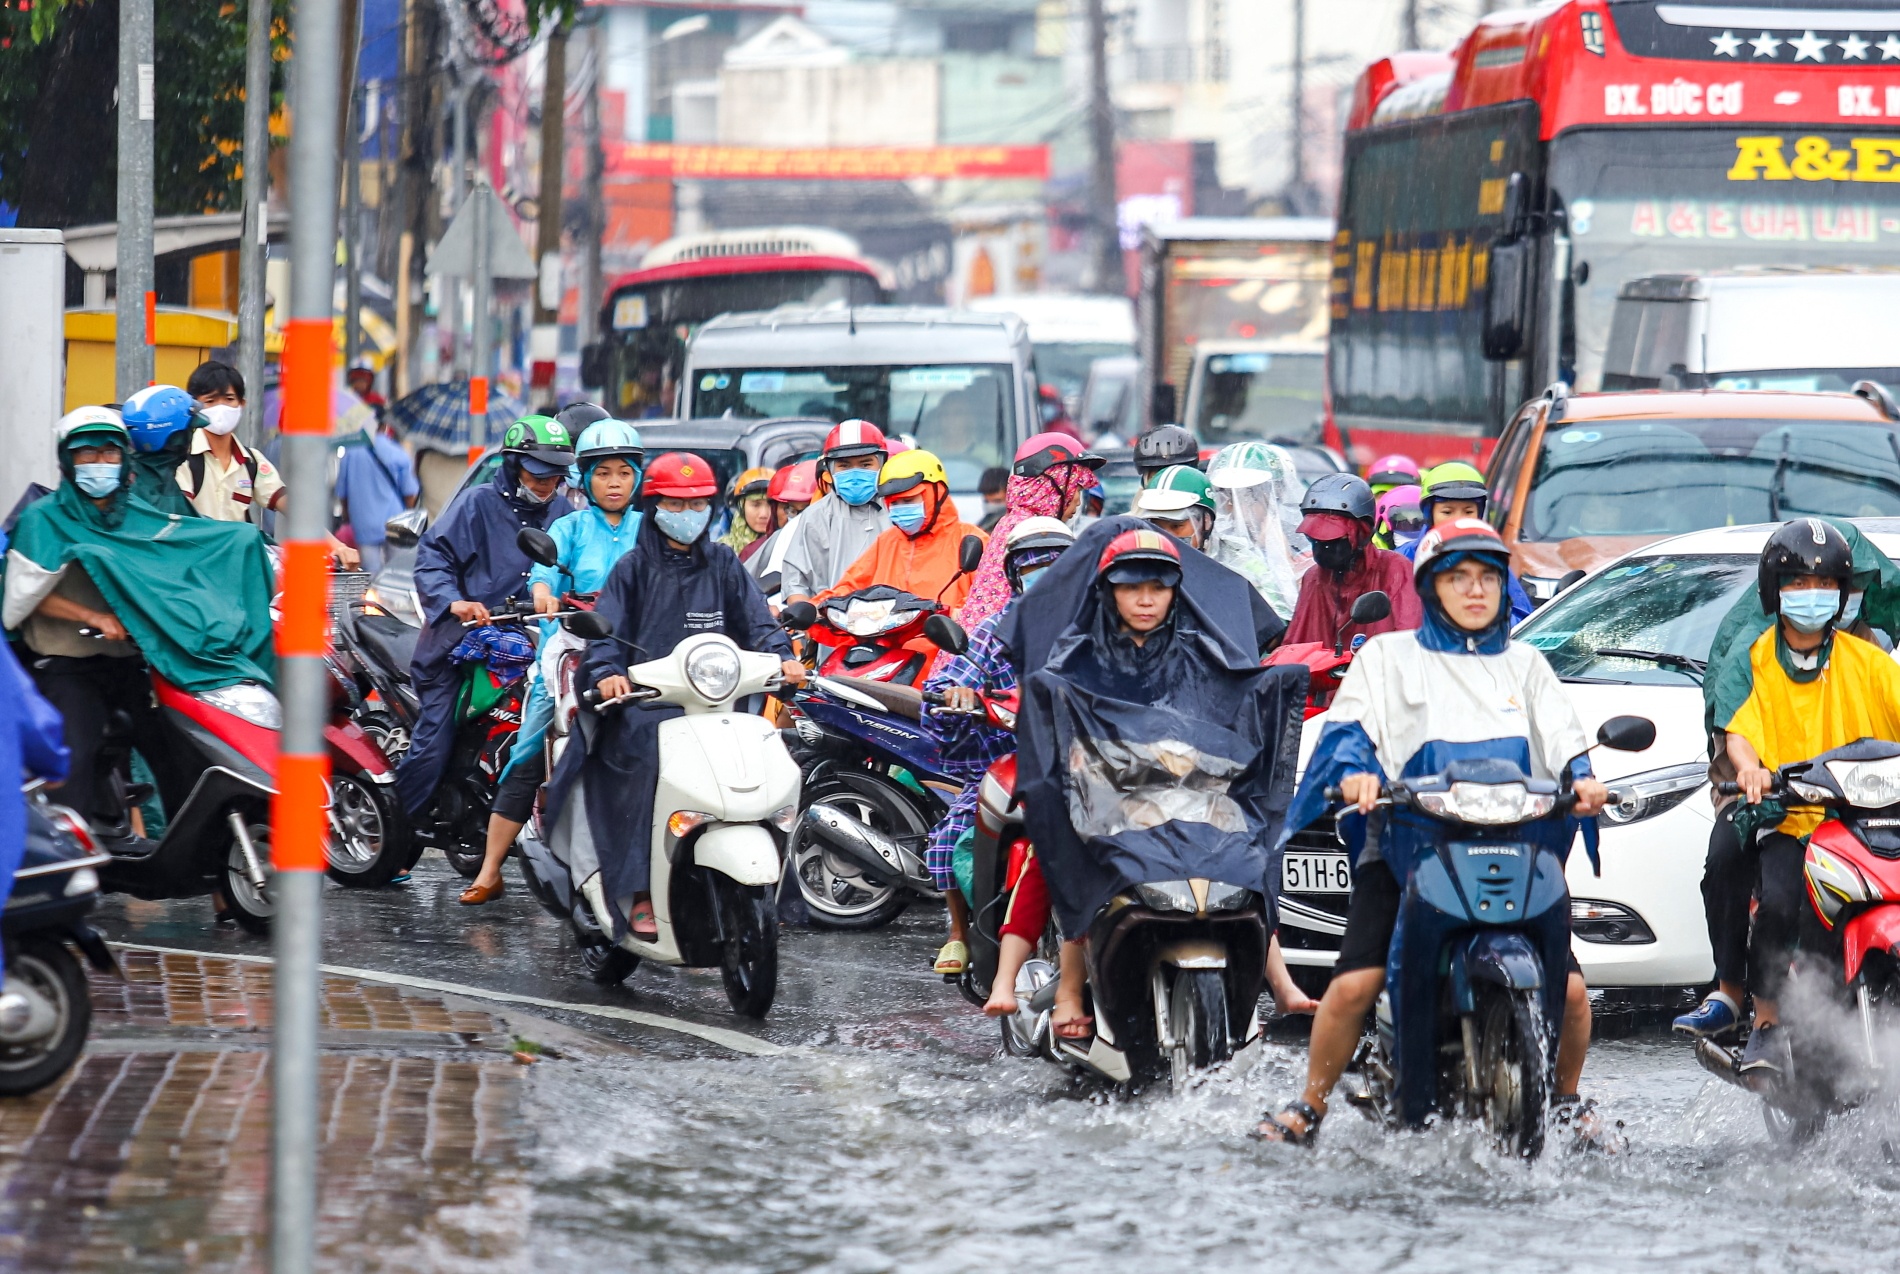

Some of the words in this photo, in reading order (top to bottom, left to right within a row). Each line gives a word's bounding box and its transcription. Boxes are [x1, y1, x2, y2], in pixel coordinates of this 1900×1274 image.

[1604, 84, 1647, 115] BX.
[1650, 77, 1702, 115] ĐỨC
[1706, 81, 1743, 115] CƠ
[1727, 136, 1900, 182] A&E
[848, 711, 919, 739] VISION
[1467, 846, 1519, 857] HONDA
